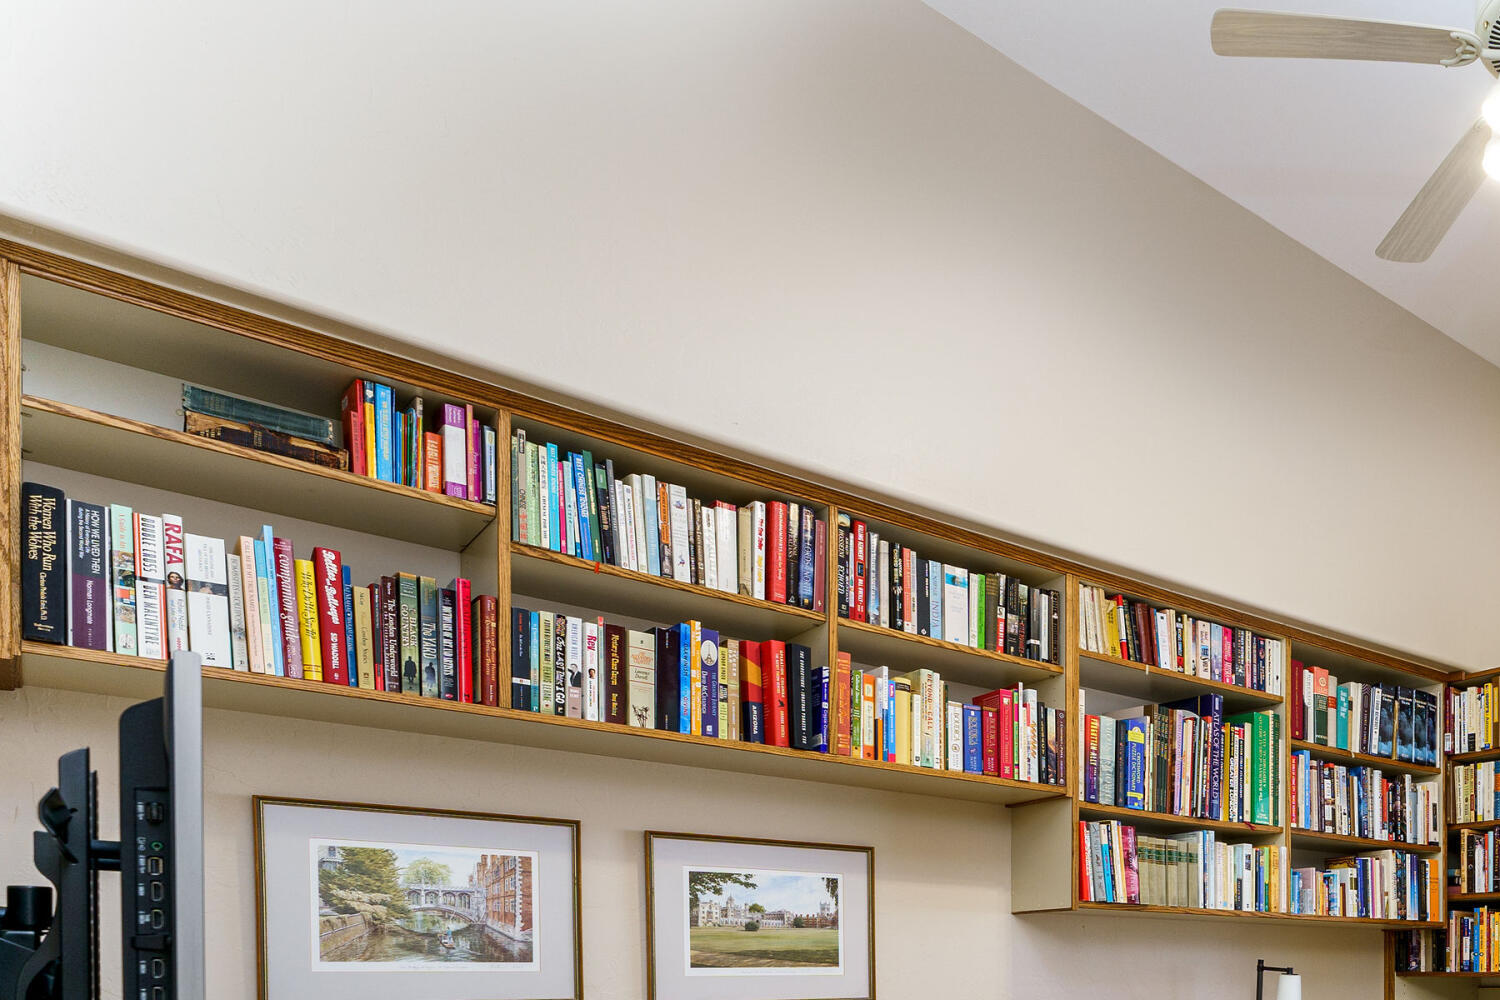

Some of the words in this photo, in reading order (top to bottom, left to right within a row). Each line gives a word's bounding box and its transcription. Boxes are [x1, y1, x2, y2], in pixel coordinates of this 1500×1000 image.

[28, 495, 42, 515] With
[42, 498, 56, 529] Women
[29, 516, 42, 530] the
[29, 531, 42, 559] Wolves
[42, 532, 56, 551] Who
[165, 523, 183, 564] RAFA
[43, 553, 56, 571] Run
[277, 554, 295, 612] companion
[280, 613, 299, 643] guide
[388, 613, 396, 637] London
[390, 639, 398, 677] Underworld
[1212, 712, 1220, 736] ATLAS
[1213, 738, 1220, 747] OF
[1212, 750, 1220, 766] THE
[1212, 768, 1220, 798] WORLD
